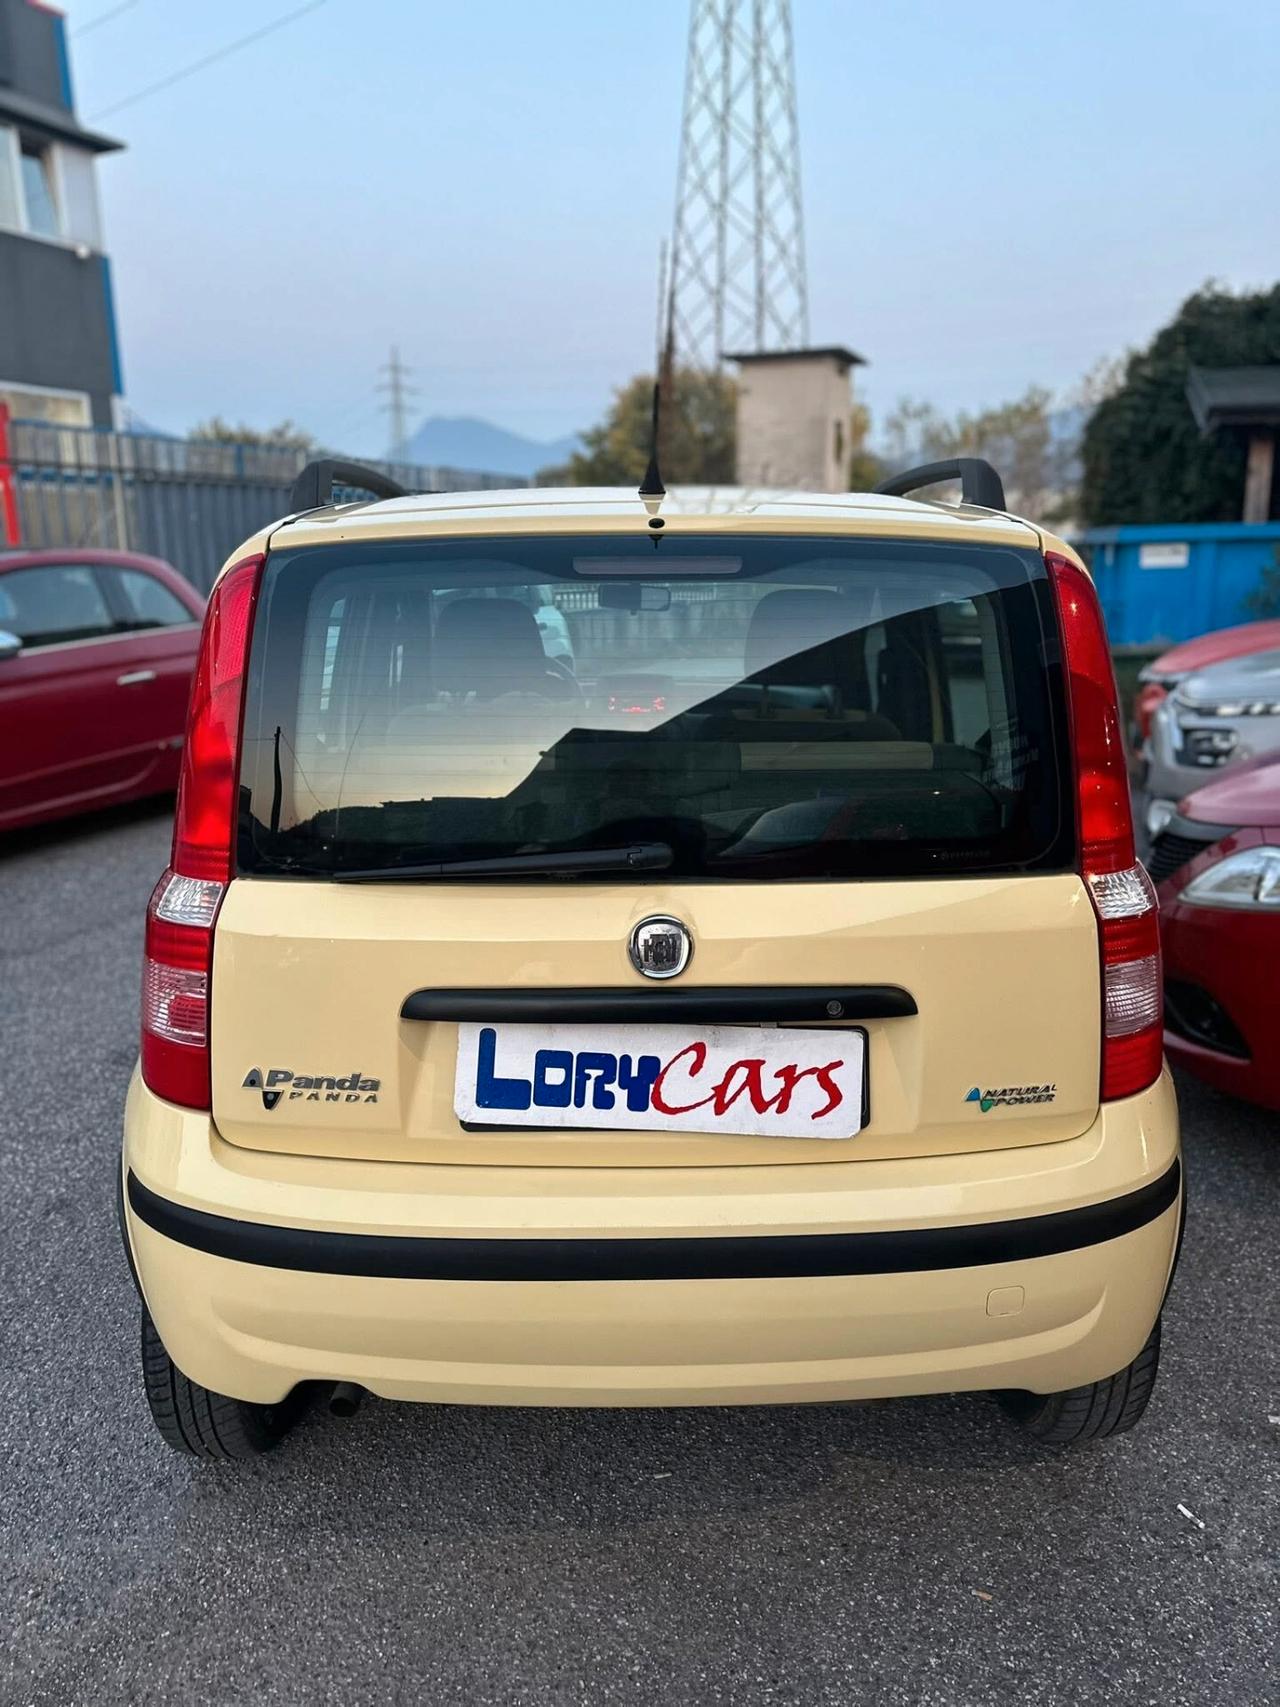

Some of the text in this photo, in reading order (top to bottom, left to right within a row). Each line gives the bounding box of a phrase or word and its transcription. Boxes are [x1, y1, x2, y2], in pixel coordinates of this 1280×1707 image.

[266, 1069, 381, 1092] Panda
[289, 1091, 378, 1103] PANDA
[983, 1084, 1057, 1098] NATURAL
[991, 1094, 1056, 1106] POWER
